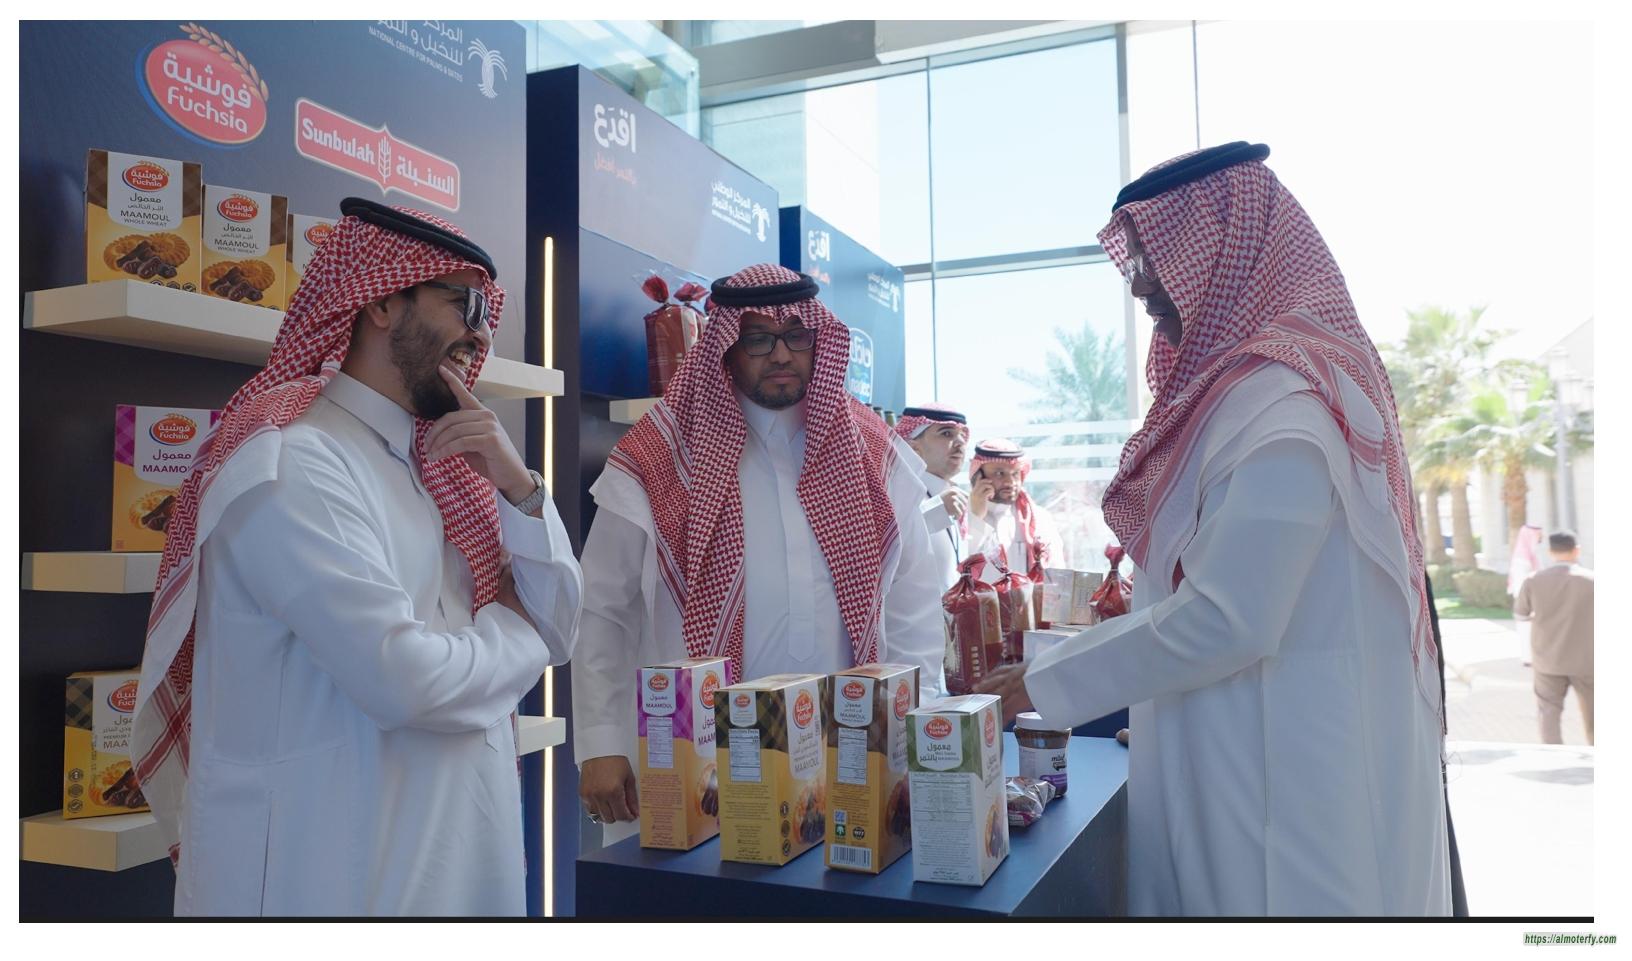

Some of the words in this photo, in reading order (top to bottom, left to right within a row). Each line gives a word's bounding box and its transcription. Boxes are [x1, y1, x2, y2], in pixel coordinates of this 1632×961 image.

[163, 52, 251, 108] فوشية
[168, 86, 248, 134] Fuchsia
[302, 118, 375, 165] Sunbulah
[396, 155, 455, 196] السنبلة
[132, 178, 162, 187] Fuchsia
[130, 193, 162, 203] معمول
[120, 210, 171, 222] MAAMOUL
[214, 239, 259, 250] MAAMOUL
[152, 449, 192, 461] معمول
[142, 465, 188, 473] MAAMO
[927, 743, 951, 752] معمول
